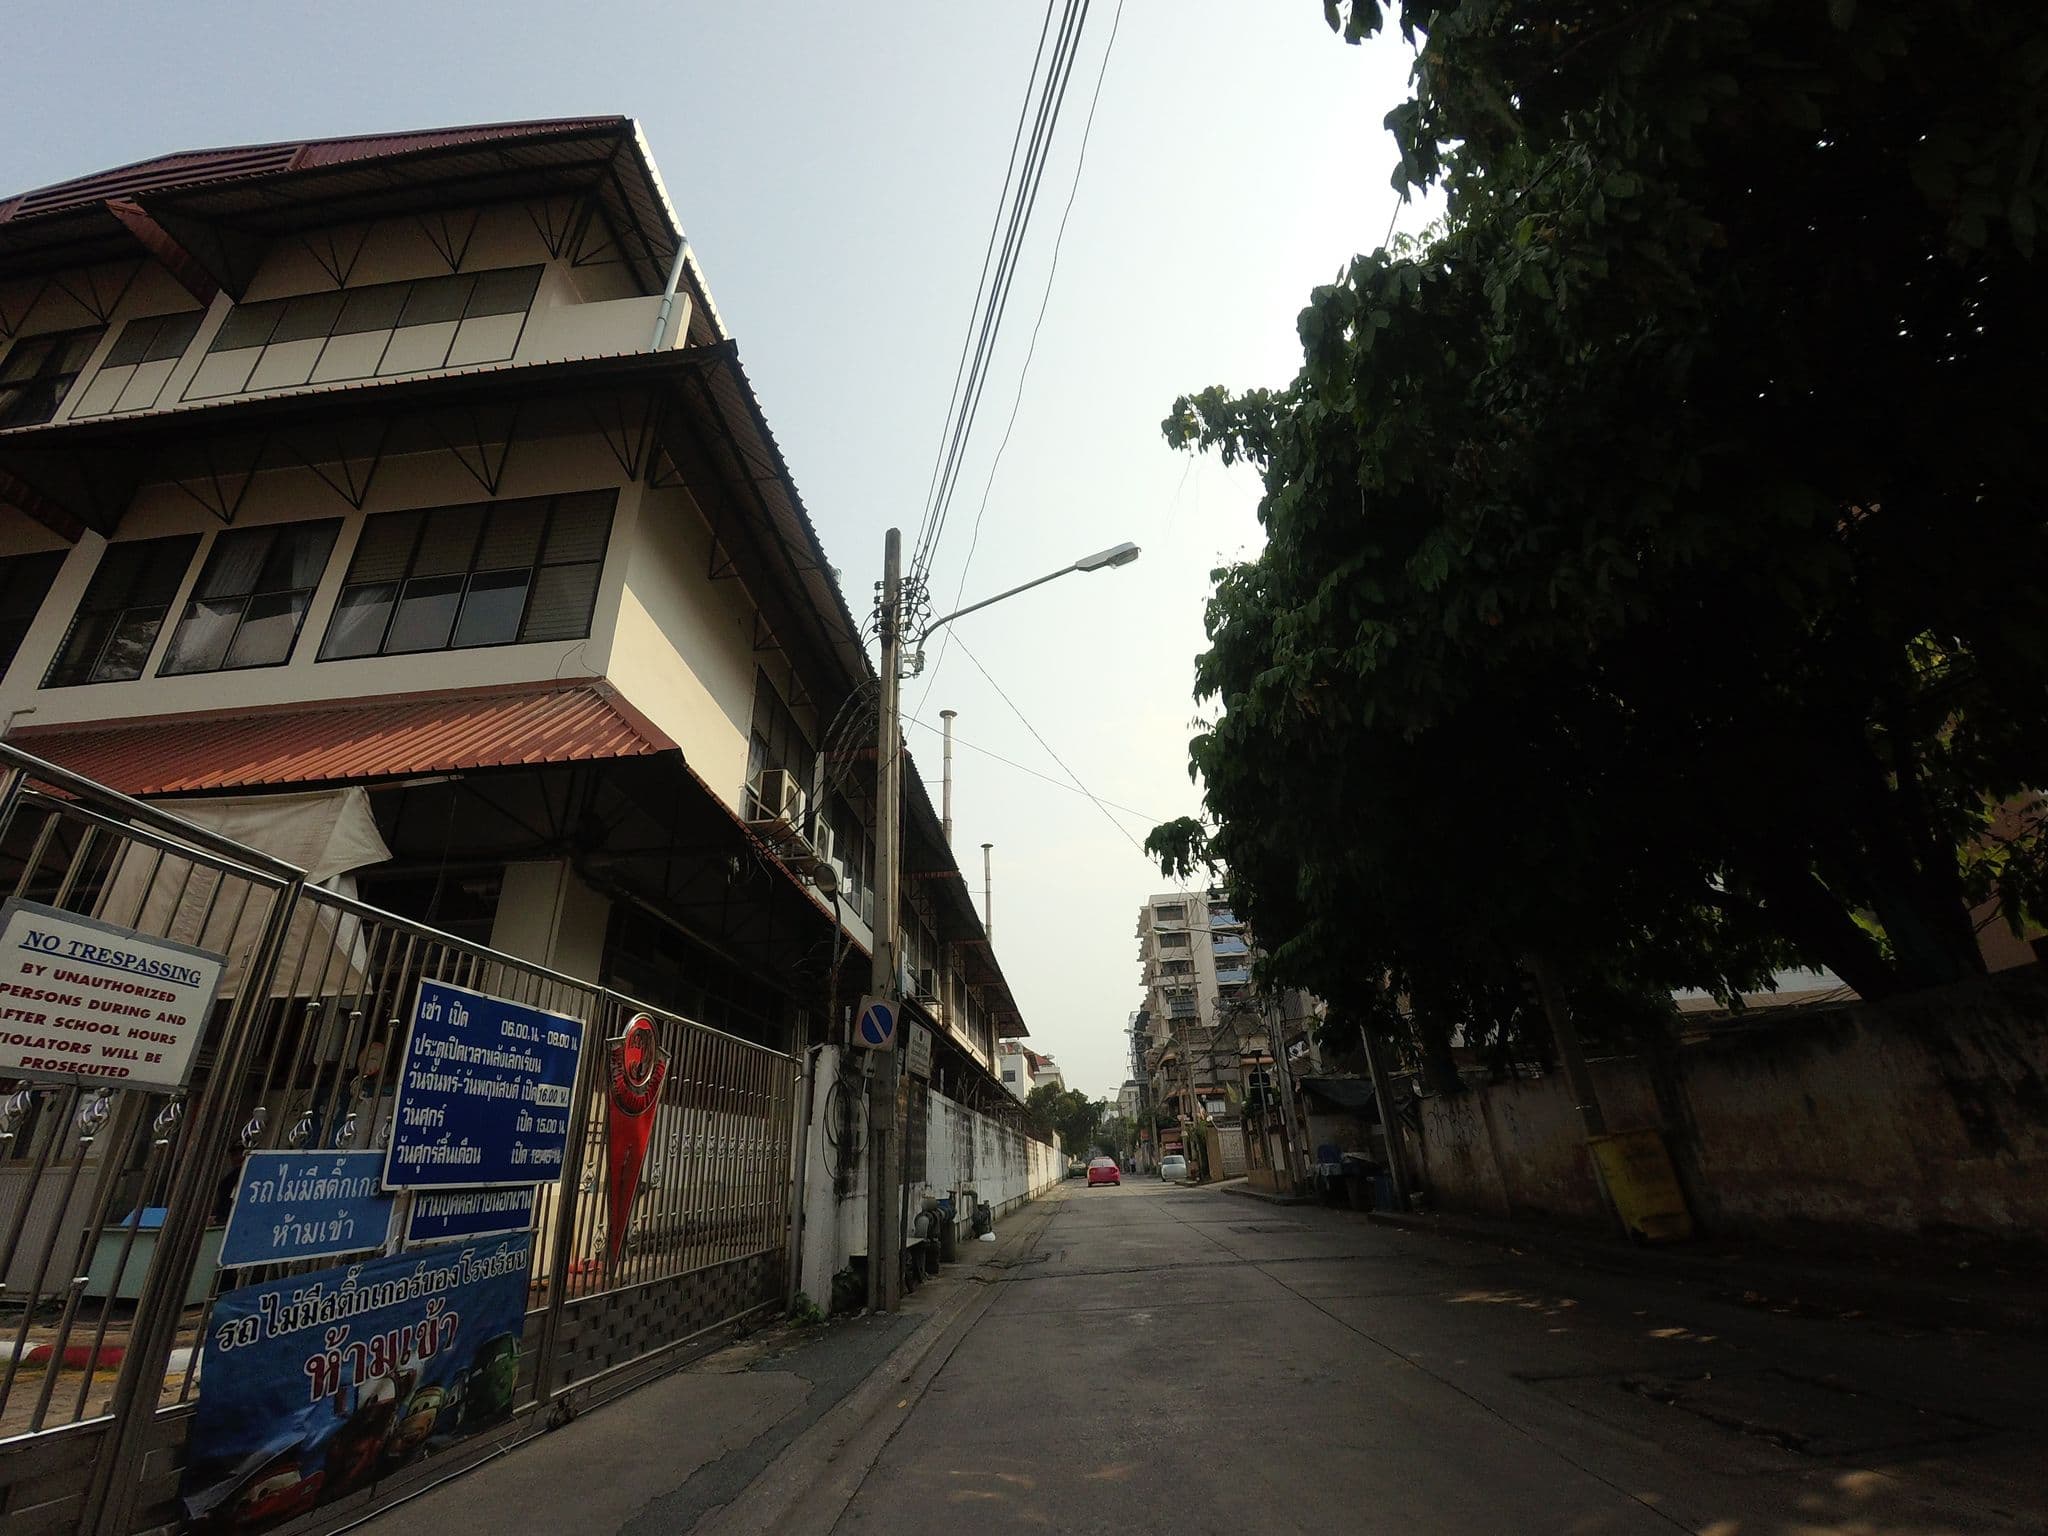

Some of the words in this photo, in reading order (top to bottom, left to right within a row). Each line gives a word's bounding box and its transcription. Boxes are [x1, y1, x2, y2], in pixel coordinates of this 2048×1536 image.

[23, 930, 60, 951] NO
[68, 940, 202, 985] TRESPASSING
[20, 962, 48, 977] BY
[53, 969, 177, 1003] UNAUTHORIZED
[0, 982, 82, 1007] PERSONS
[88, 1000, 151, 1019] DURING
[156, 1012, 187, 1026] AND
[0, 1008, 47, 1025] FTER
[53, 1017, 120, 1036] SCHOOL
[127, 1028, 177, 1045] HOURS
[19, 1056, 130, 1078] PROSECUTED
[102, 1046, 139, 1061] WILL
[144, 1052, 163, 1064] BE
[403, 1097, 447, 1134] วันศุกร์
[272, 1208, 355, 1247] ห้ามเข้า
[304, 1297, 459, 1402] ห้ามเข้า
